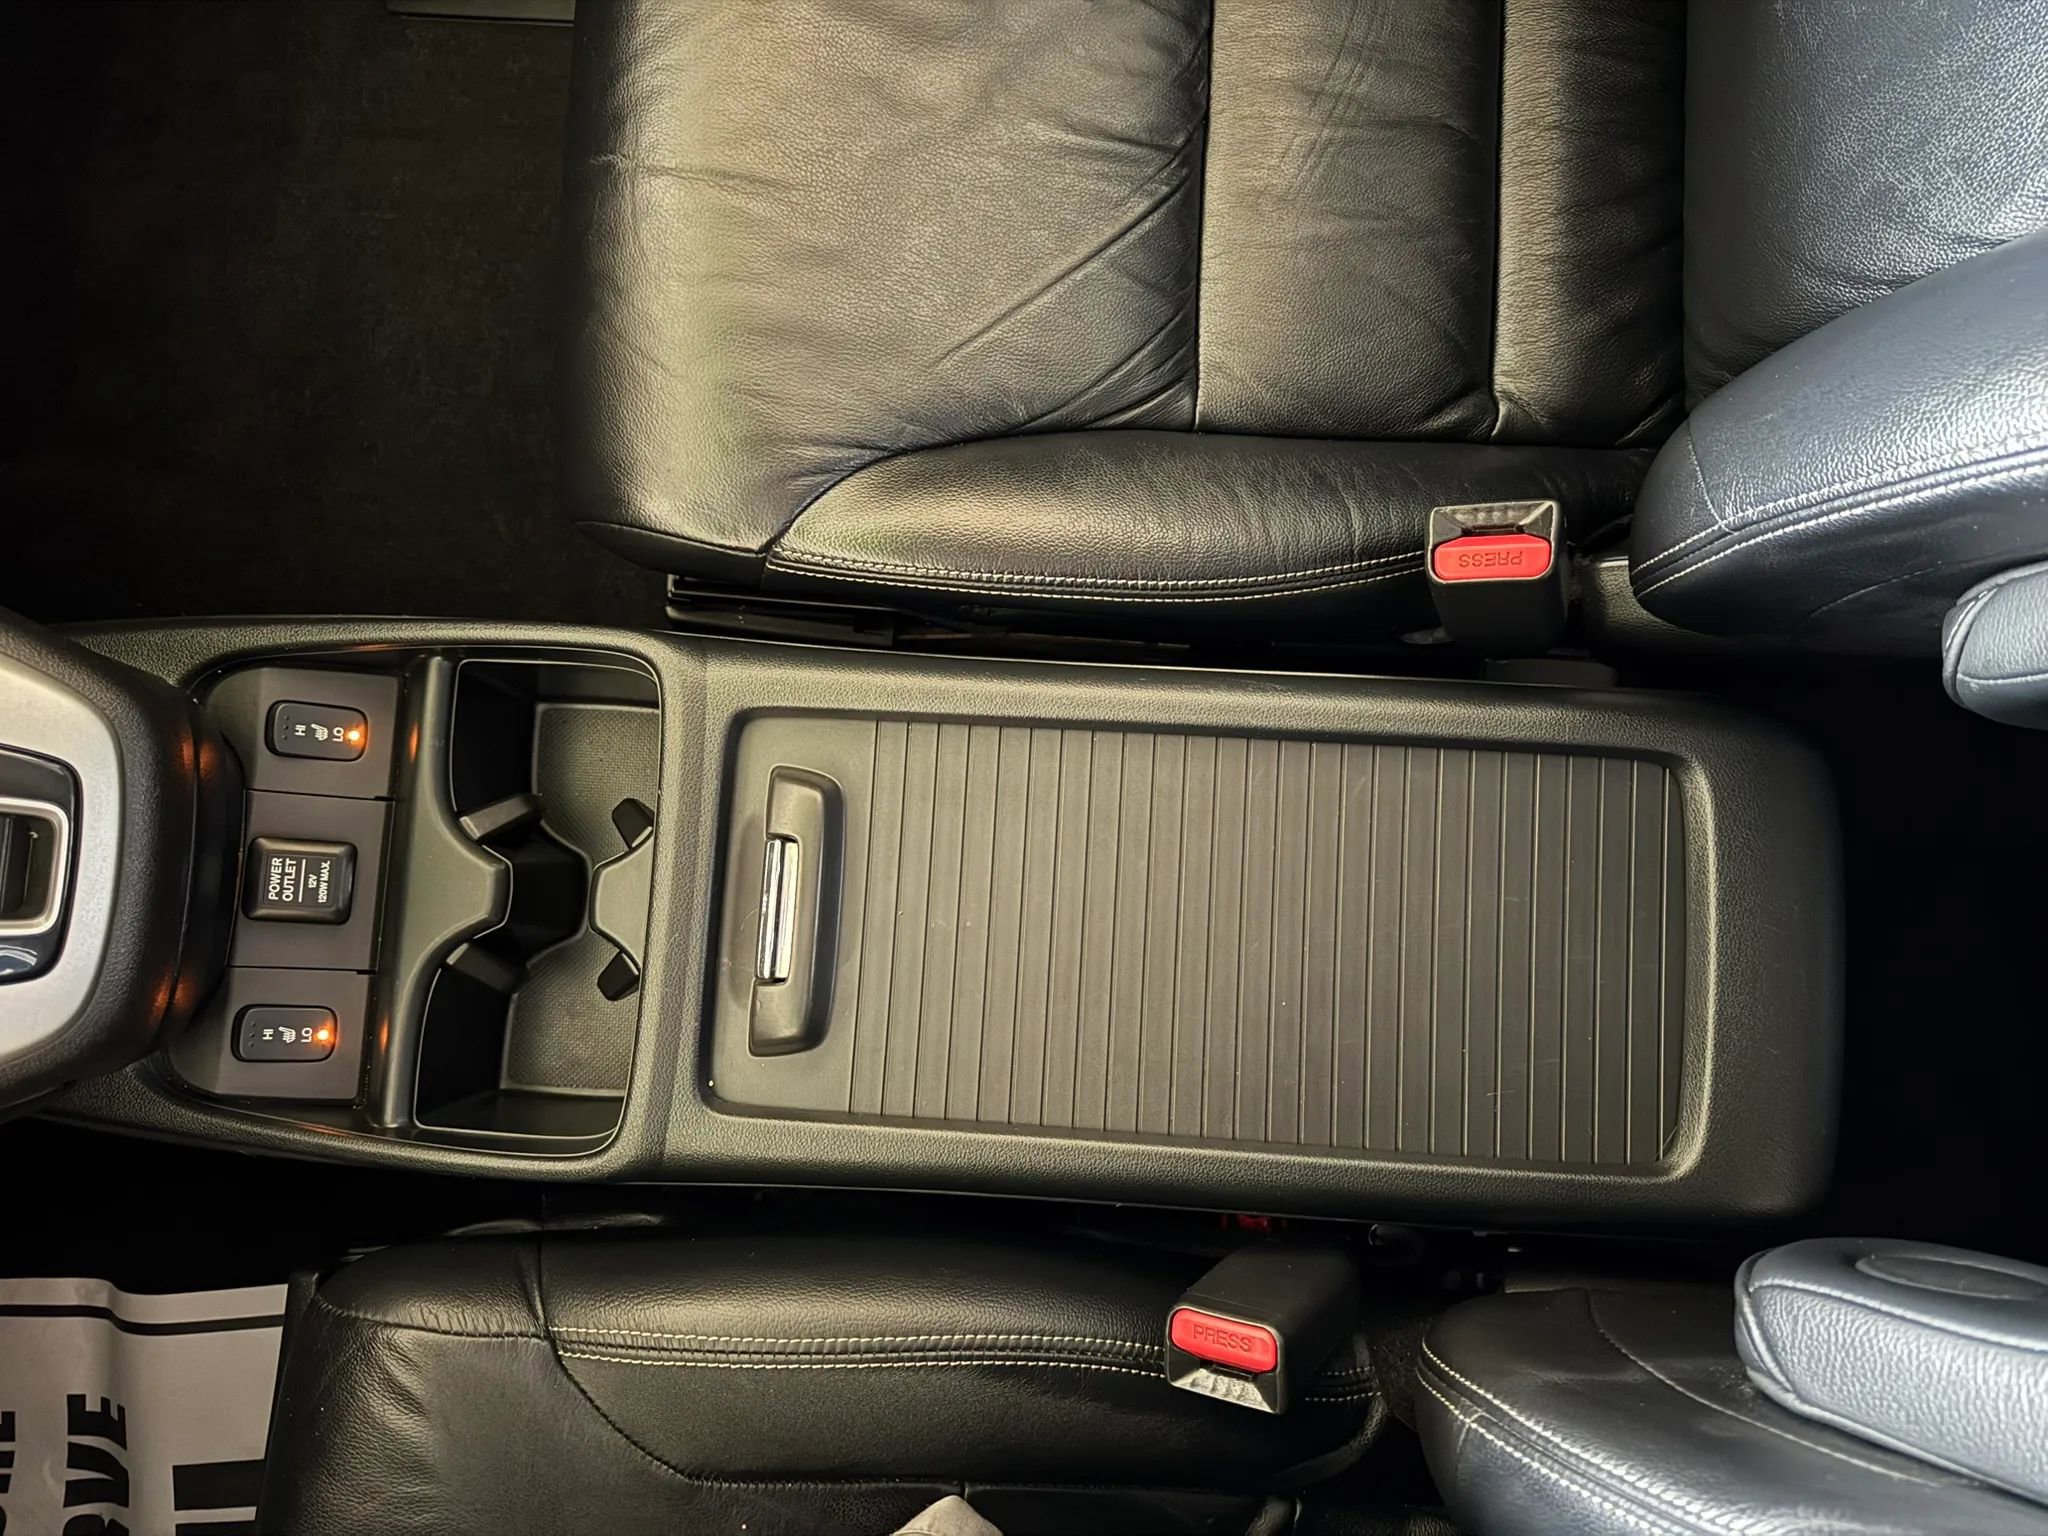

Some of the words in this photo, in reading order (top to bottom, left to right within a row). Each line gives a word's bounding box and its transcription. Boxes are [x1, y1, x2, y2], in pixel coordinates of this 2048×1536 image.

[1458, 550, 1523, 568] PRESS
[294, 724, 307, 736] HI
[332, 727, 344, 742] LO
[268, 857, 283, 900] POWER
[282, 857, 297, 902] OUTLET
[308, 874, 318, 888] 12V
[317, 881, 329, 903] 120W
[262, 1028, 274, 1040] HI
[301, 1027, 313, 1043] LO
[1192, 1324, 1253, 1353] PRESS
